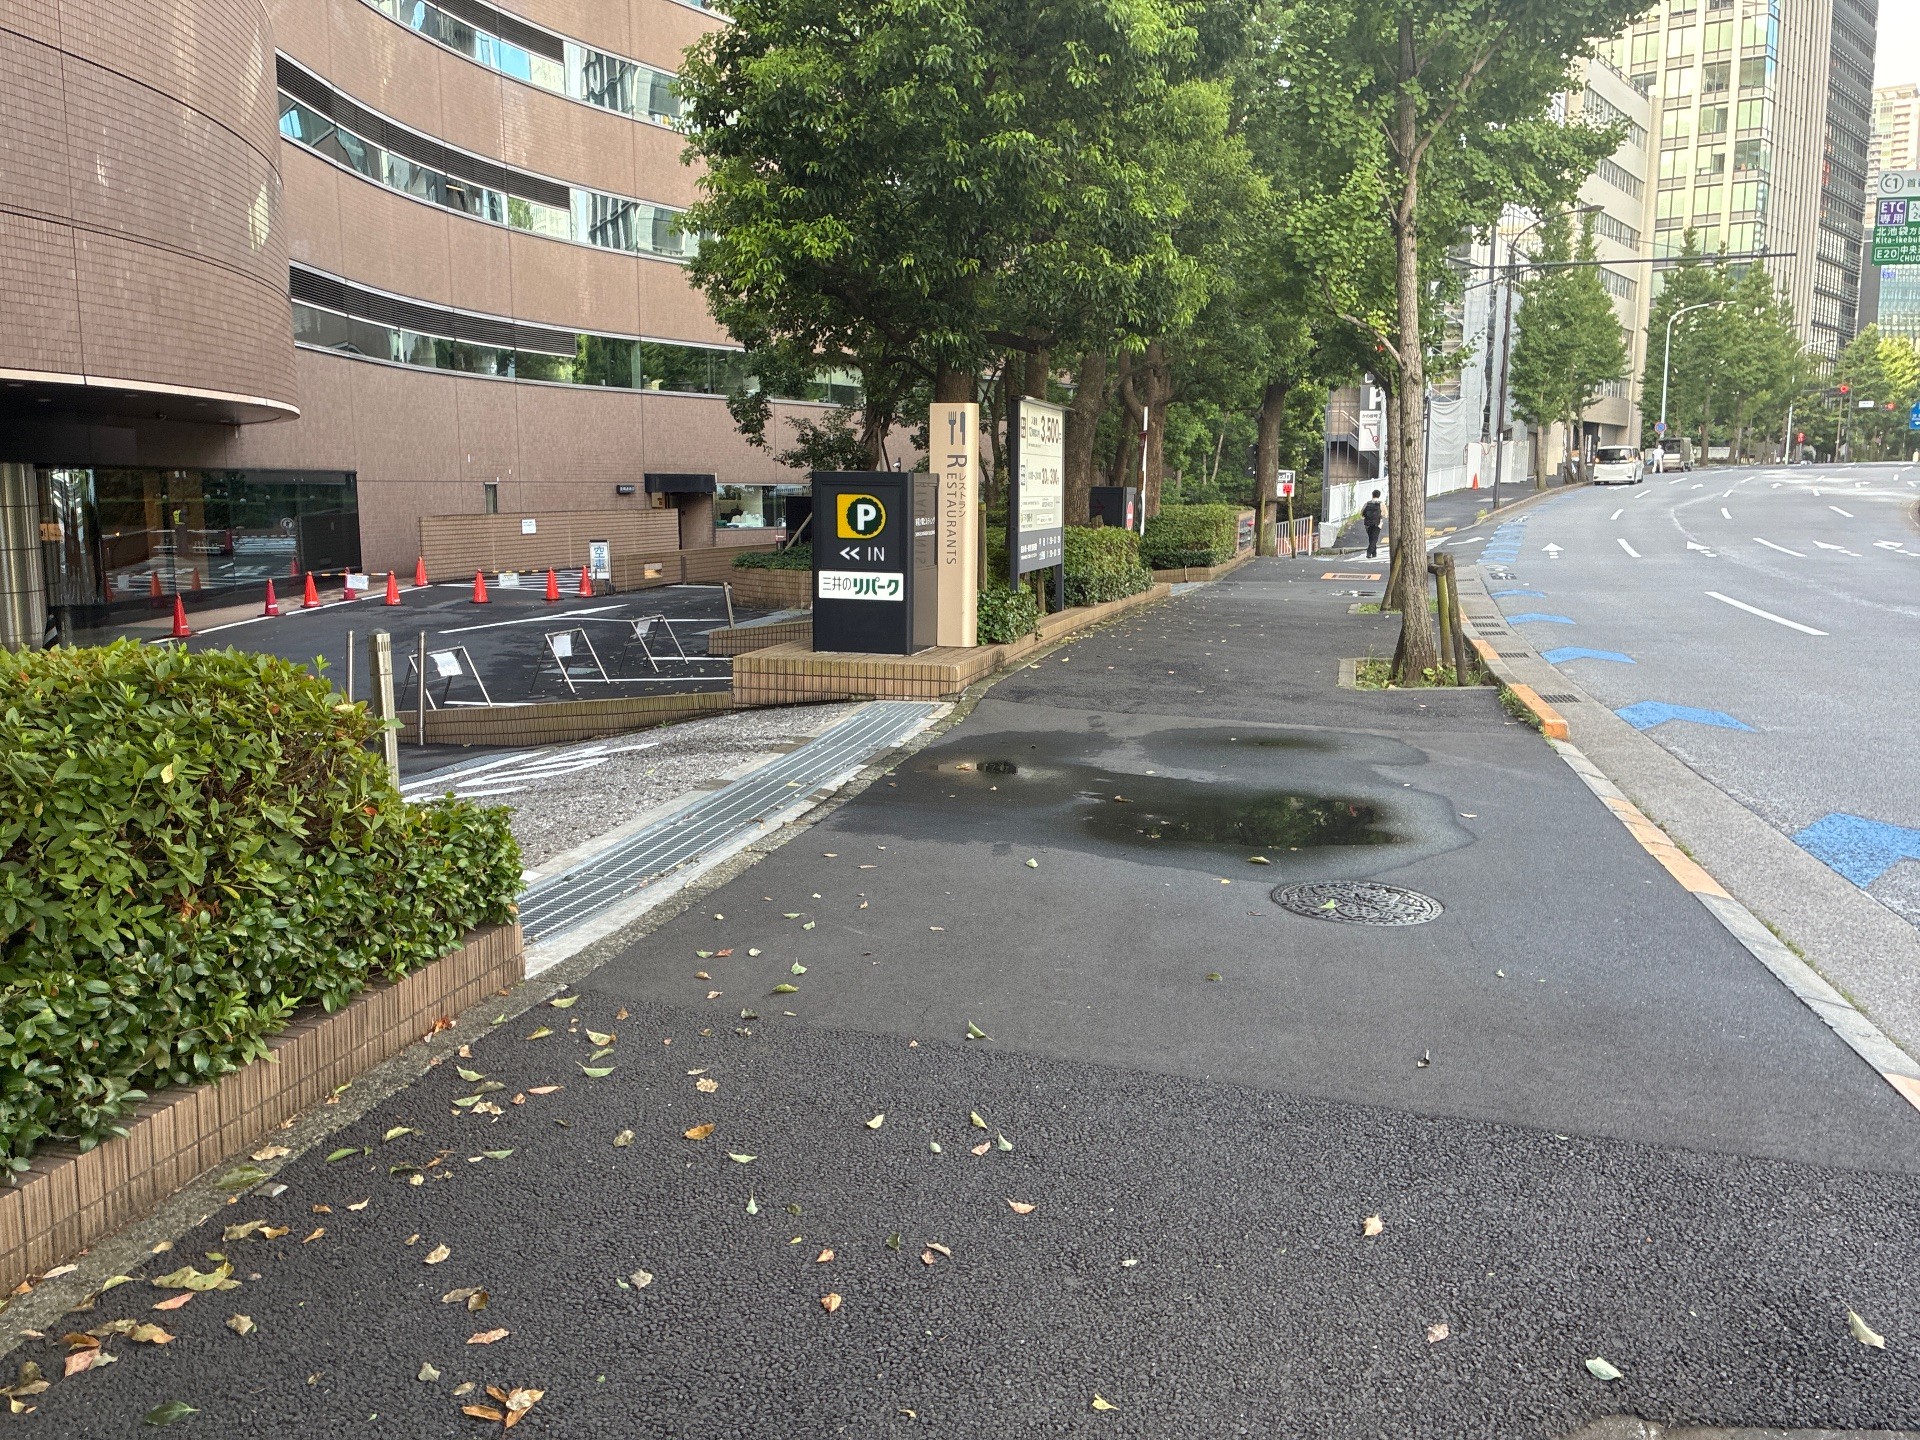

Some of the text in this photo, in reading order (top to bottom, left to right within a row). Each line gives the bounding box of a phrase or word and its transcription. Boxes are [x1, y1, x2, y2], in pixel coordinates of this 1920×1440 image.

[1885, 177, 1899, 189] C1
[1881, 201, 1905, 213] ETC
[1880, 213, 1904, 224] 専用
[1876, 226, 1920, 237] 北池袋方
[1876, 249, 1897, 259] E20
[947, 454, 967, 565] RESTAURANTS
[857, 503, 877, 531] P
[867, 546, 885, 562] IN
